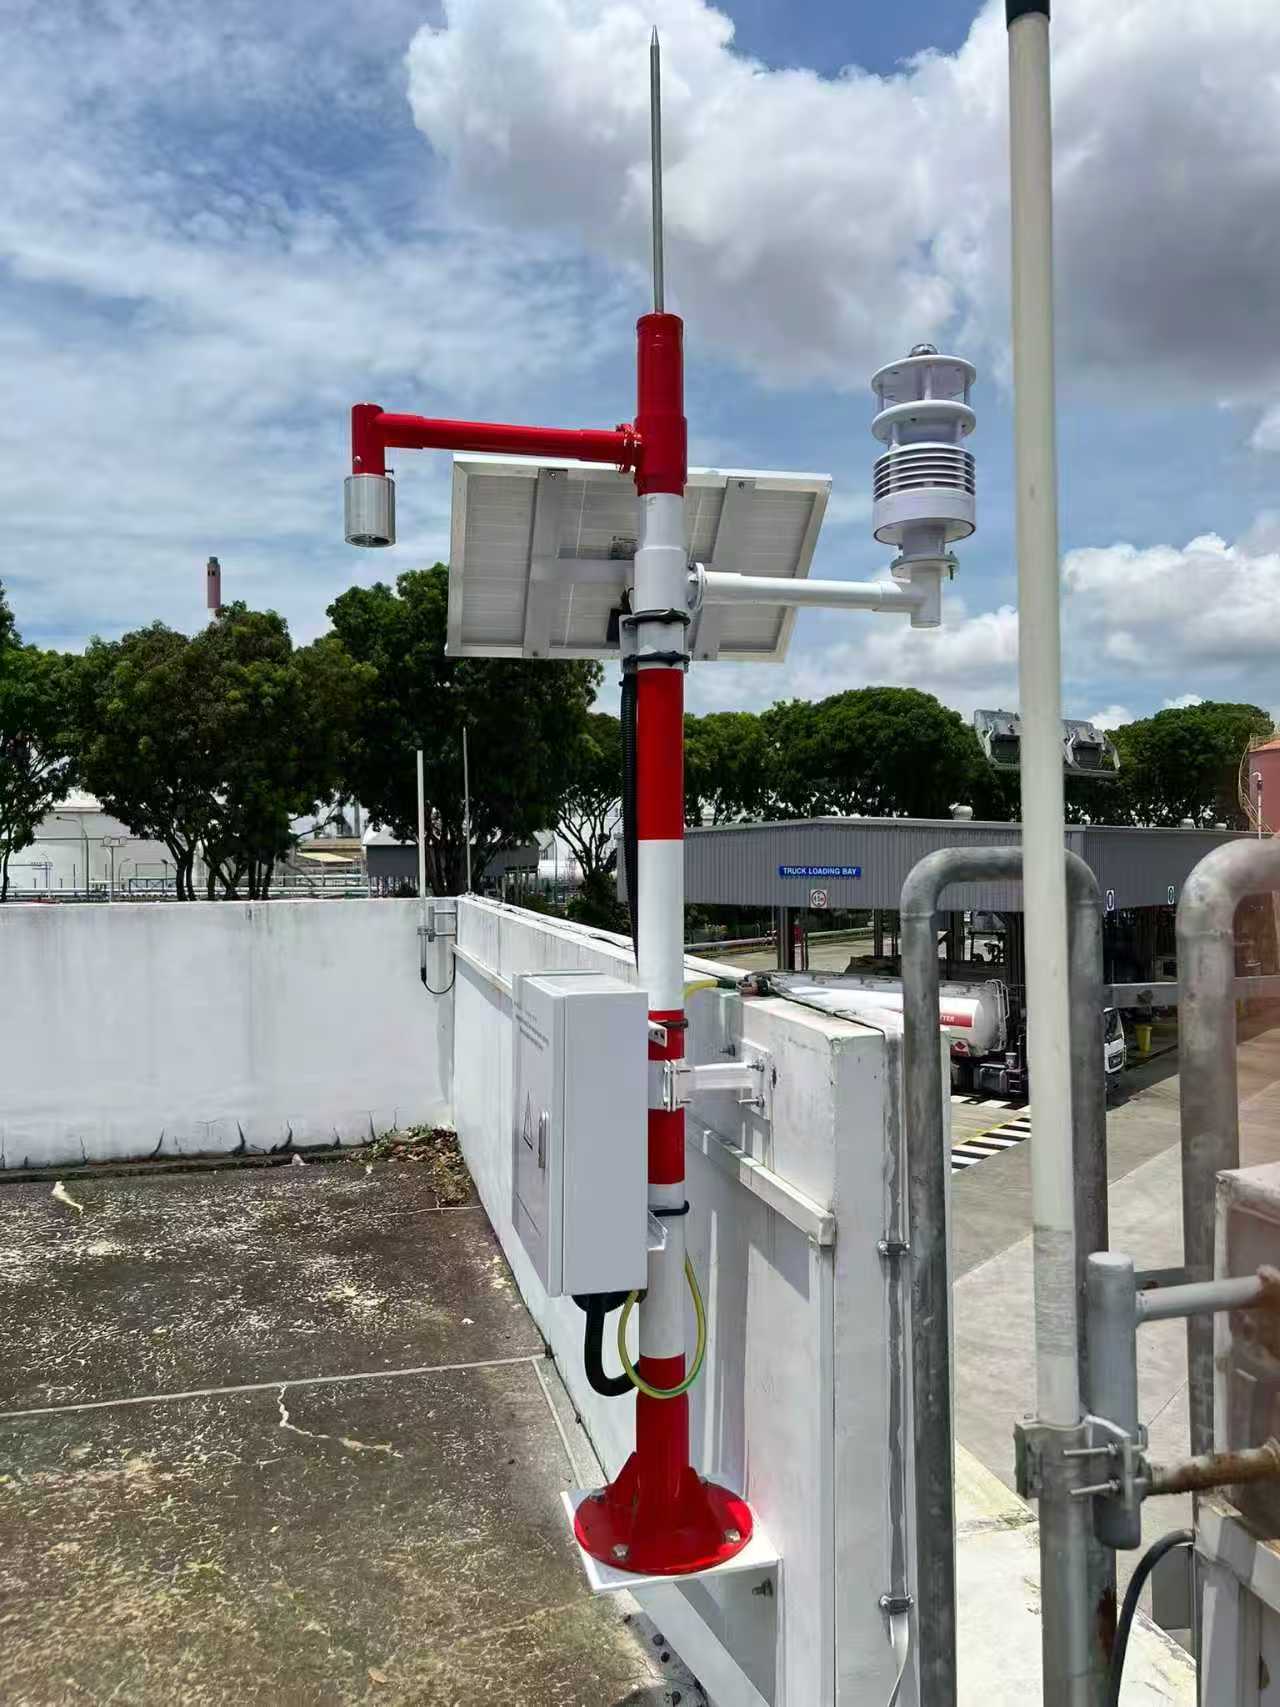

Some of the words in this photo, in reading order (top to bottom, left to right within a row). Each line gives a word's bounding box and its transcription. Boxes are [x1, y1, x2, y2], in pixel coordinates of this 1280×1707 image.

[783, 867, 807, 875] TRUCK
[808, 867, 841, 875] LOADING
[842, 867, 857, 875] BAY
